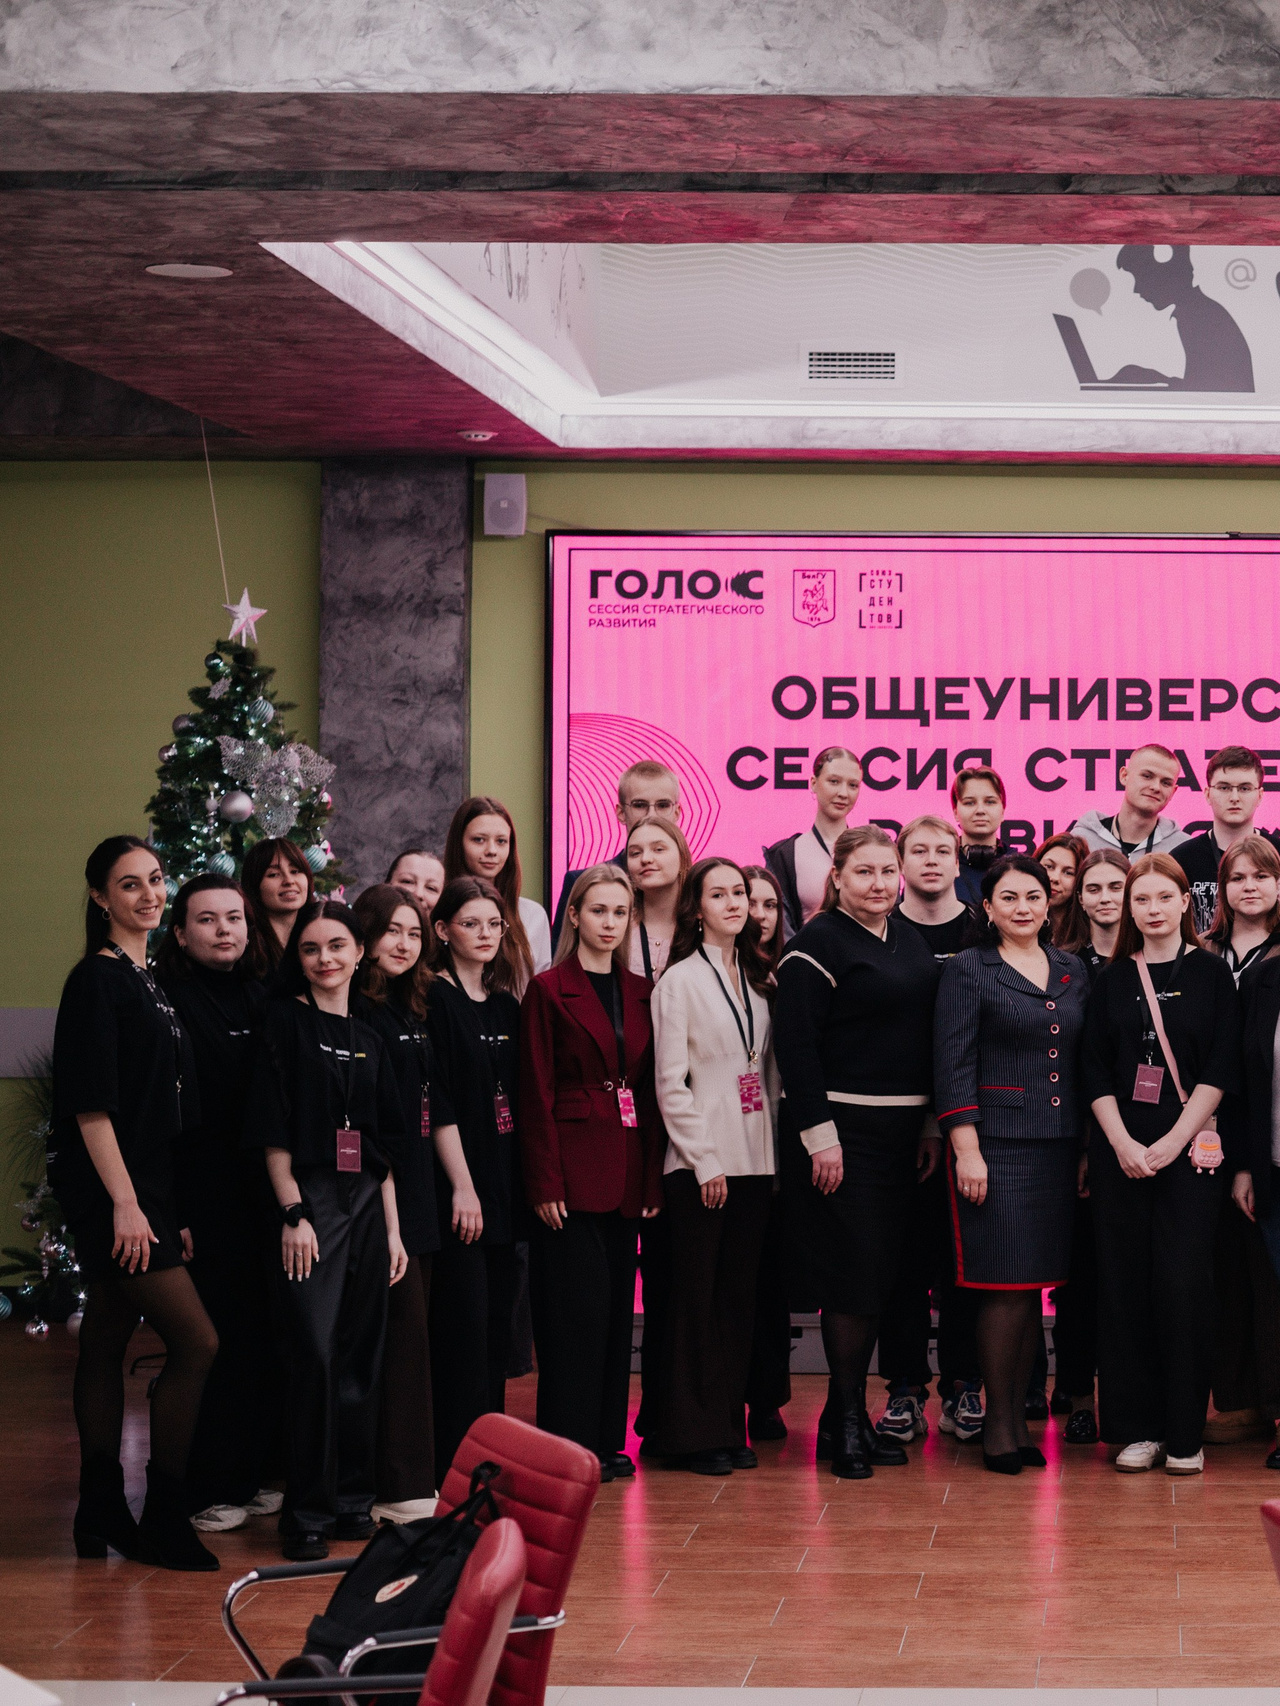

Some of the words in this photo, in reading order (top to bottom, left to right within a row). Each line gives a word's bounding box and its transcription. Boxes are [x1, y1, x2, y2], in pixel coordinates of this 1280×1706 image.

[589, 569, 764, 600] ГОЛОС
[870, 579, 893, 589] СТУ
[869, 596, 893, 607] ДЕН
[588, 604, 639, 615] СЕССИЯ
[643, 604, 765, 616] СТРАТЕГИЧЕСКОГО
[588, 618, 656, 629] РАЗВИТИЯ
[869, 613, 893, 624] ТОВ
[726, 746, 993, 791] СЕСИЯ
